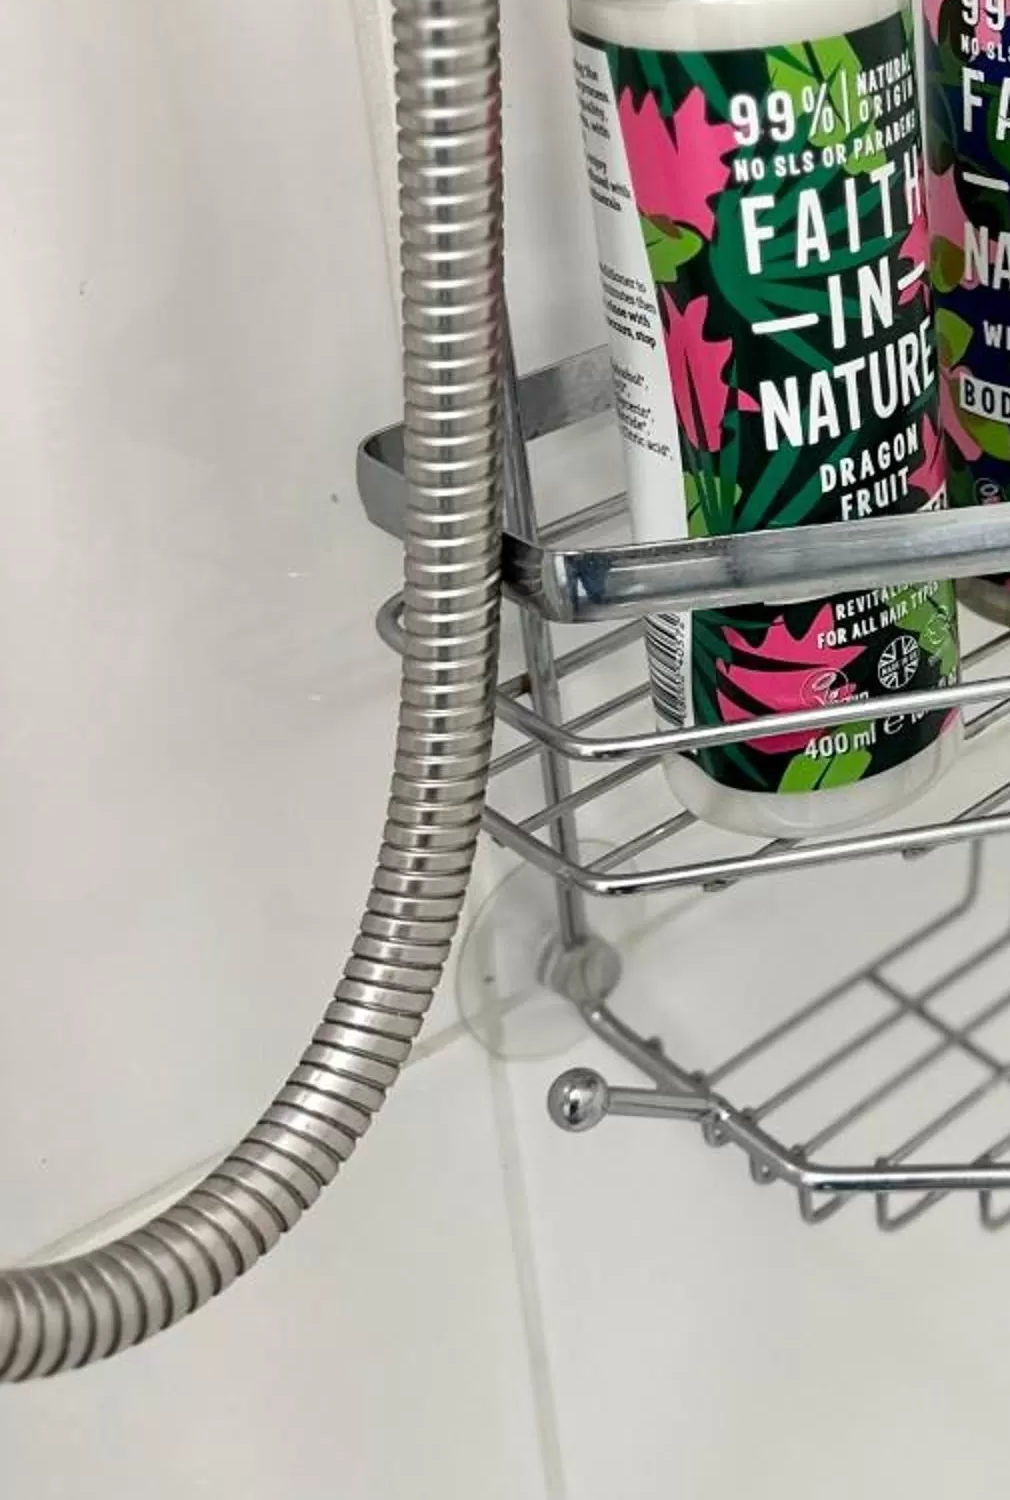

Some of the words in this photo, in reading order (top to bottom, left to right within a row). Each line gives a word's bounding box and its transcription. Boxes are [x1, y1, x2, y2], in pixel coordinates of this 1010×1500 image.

[960, 33, 979, 57] NO
[729, 82, 835, 146] 99%
[733, 157, 765, 183] NO
[773, 151, 816, 178] SLS
[821, 143, 847, 168] OR
[740, 145, 922, 276] FAITH
[827, 256, 894, 350] IN
[758, 315, 935, 452] NATURE
[819, 422, 919, 494] DRAGON
[841, 465, 909, 521] FRUIT
[817, 627, 848, 650] FOR
[851, 617, 878, 641] ALL
[879, 600, 909, 629] HAIR
[804, 731, 849, 760] 400
[852, 720, 877, 748] ml
